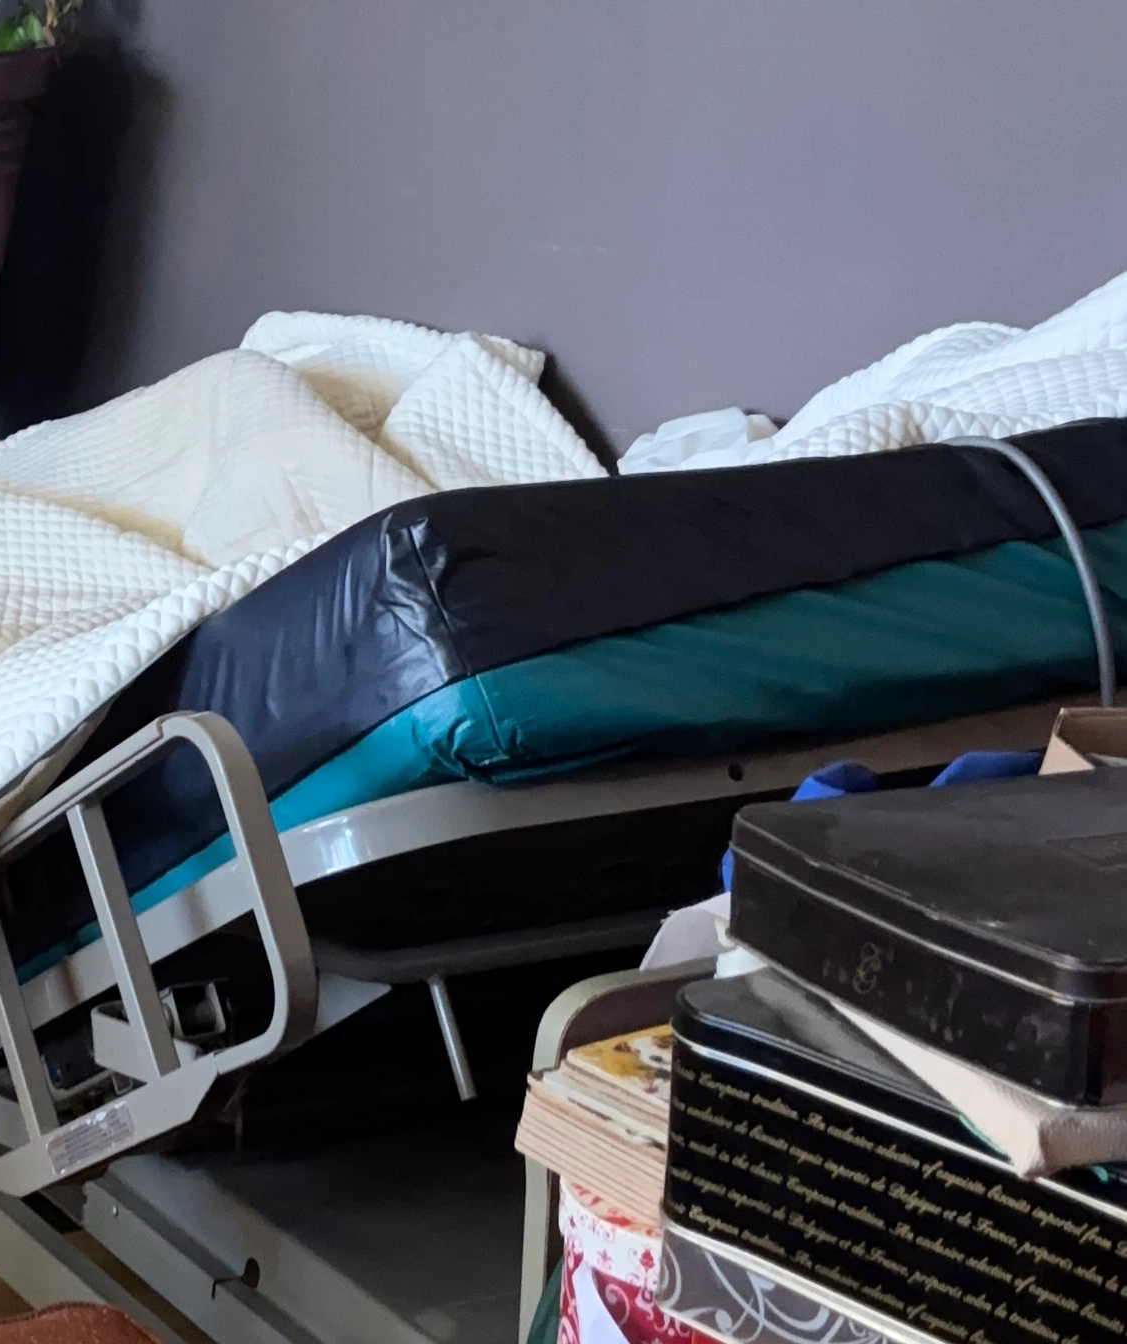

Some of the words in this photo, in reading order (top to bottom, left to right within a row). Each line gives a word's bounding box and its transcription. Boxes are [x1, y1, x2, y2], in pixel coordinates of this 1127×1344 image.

[686, 1106, 732, 1129] exclusive
[733, 1120, 748, 1134] de
[748, 1124, 788, 1151] biscuits
[788, 1145, 823, 1165] exquis
[870, 1176, 885, 1191] de
[888, 1183, 941, 1214] Belgique
[942, 1209, 957, 1220] et
[956, 1211, 971, 1227] de
[1073, 1265, 1103, 1285] selon
[1104, 1275, 1118, 1292] la
[688, 1140, 717, 1157] made
[731, 1153, 749, 1169] the
[749, 1161, 783, 1184] classic
[786, 1175, 836, 1207] European
[888, 1221, 914, 1241] An
[915, 1235, 964, 1262] exclusive
[965, 1256, 1012, 1283] selection
[1013, 1275, 1035, 1293] of
[1028, 1283, 1078, 1311] exquisite
[1079, 1302, 1124, 1333] biscuits
[698, 1072, 750, 1101] European
[802, 1112, 825, 1130] An
[826, 1125, 874, 1150] exclusive
[874, 1143, 920, 1169] selection
[921, 1160, 943, 1178] of
[935, 1168, 986, 1194] exquisite
[986, 1184, 1030, 1213] biscuits
[1031, 1206, 1088, 1236] imported
[1078, 1226, 1111, 1249] from
[688, 1204, 739, 1235] European
[789, 1250, 812, 1268] An
[814, 1263, 859, 1290] exclusive
[860, 1284, 904, 1310] selection
[906, 1303, 926, 1320] of
[919, 1311, 968, 1338] exquisite
[692, 1176, 726, 1195] exquis
[771, 1206, 785, 1220] de
[787, 1212, 837, 1244] Belgique
[838, 1239, 851, 1249] et
[850, 1241, 865, 1256] de
[962, 1293, 992, 1312] selon
[993, 1302, 1007, 1318] la
[1008, 1311, 1059, 1342] tradition
